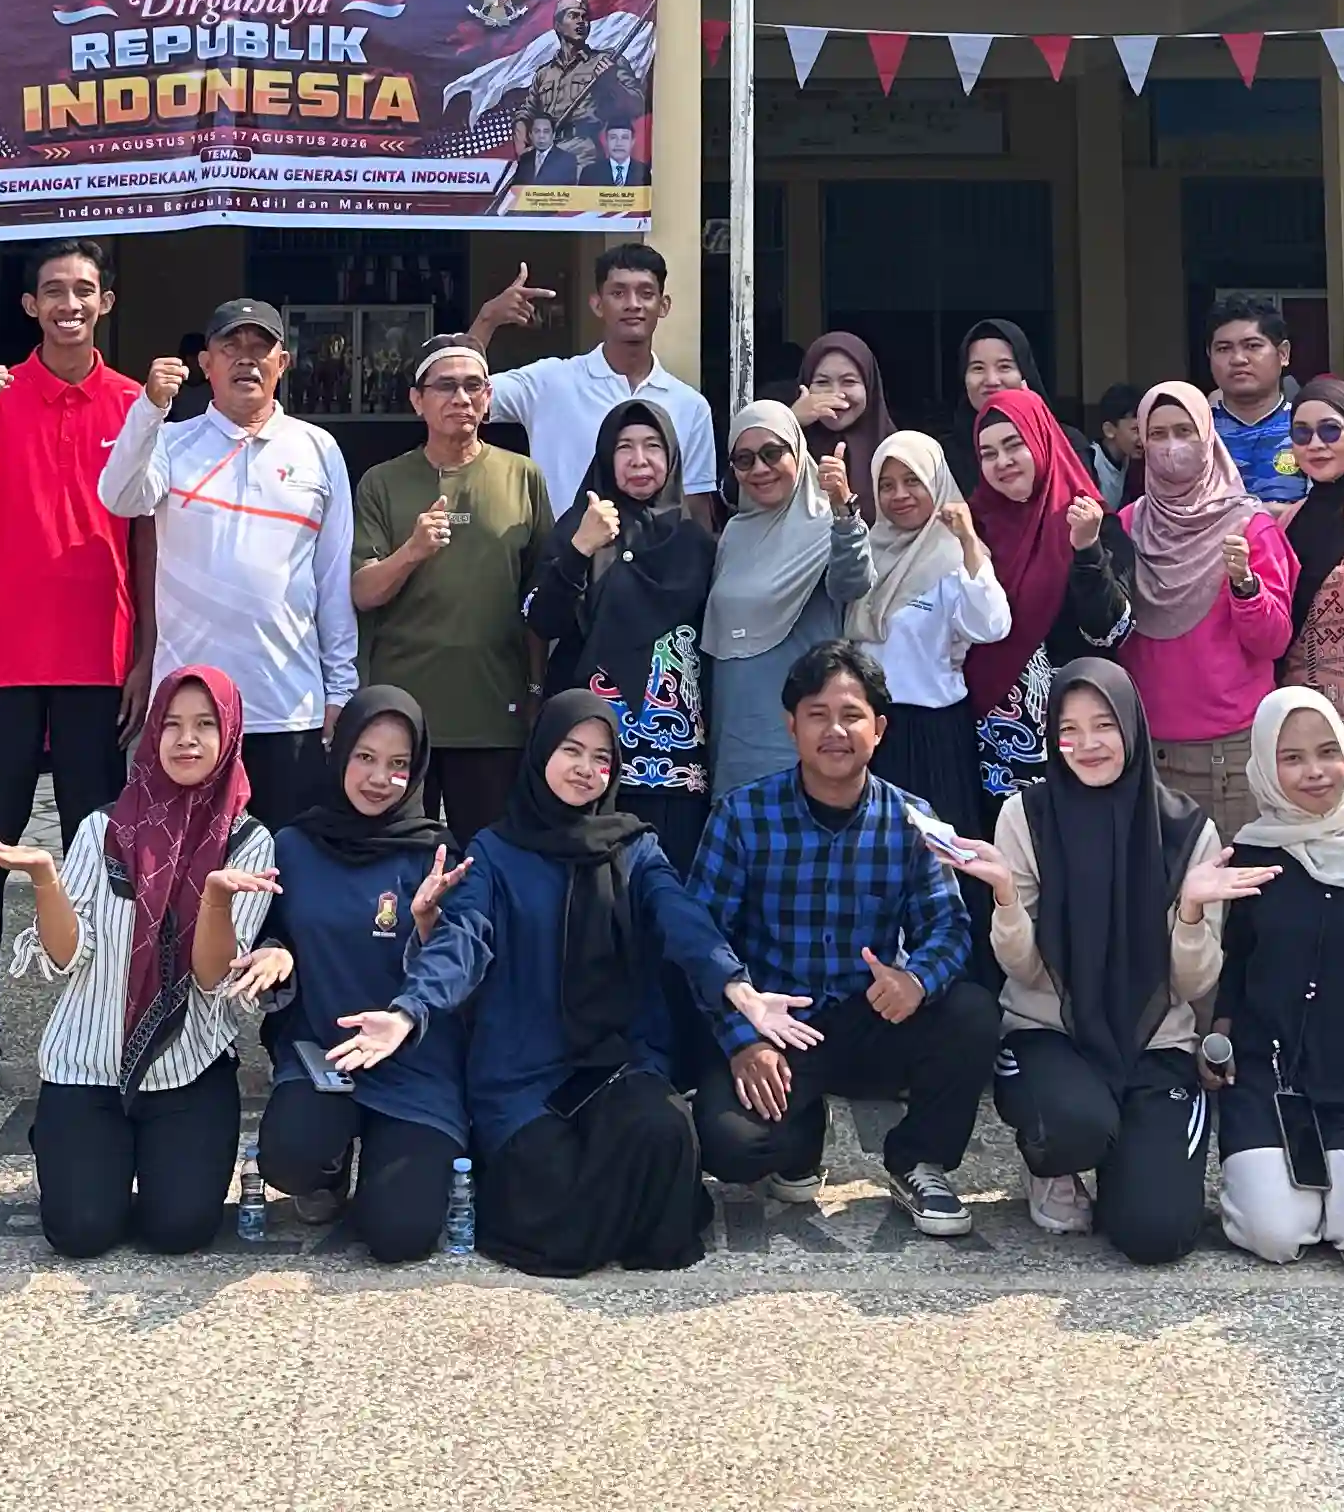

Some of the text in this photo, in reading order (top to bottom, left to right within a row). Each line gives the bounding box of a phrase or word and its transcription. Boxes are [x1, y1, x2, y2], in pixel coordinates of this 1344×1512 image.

[71, 21, 368, 72] REPUBLIK
[22, 69, 421, 132] INDONESIA
[89, 131, 367, 153] 17 AGUSTUS 1945 17 AGUSTUS 2026
[208, 149, 243, 160] TEMA:
[87, 169, 198, 189] KEMERDEKAAN,
[201, 164, 279, 182] WUJUDKAN
[284, 169, 358, 183] GENERASI
[362, 170, 406, 183] CINTA
[411, 170, 490, 185] INDONESIA
[59, 195, 413, 219] Indonesia Berdaulat Adil dan Makmur
